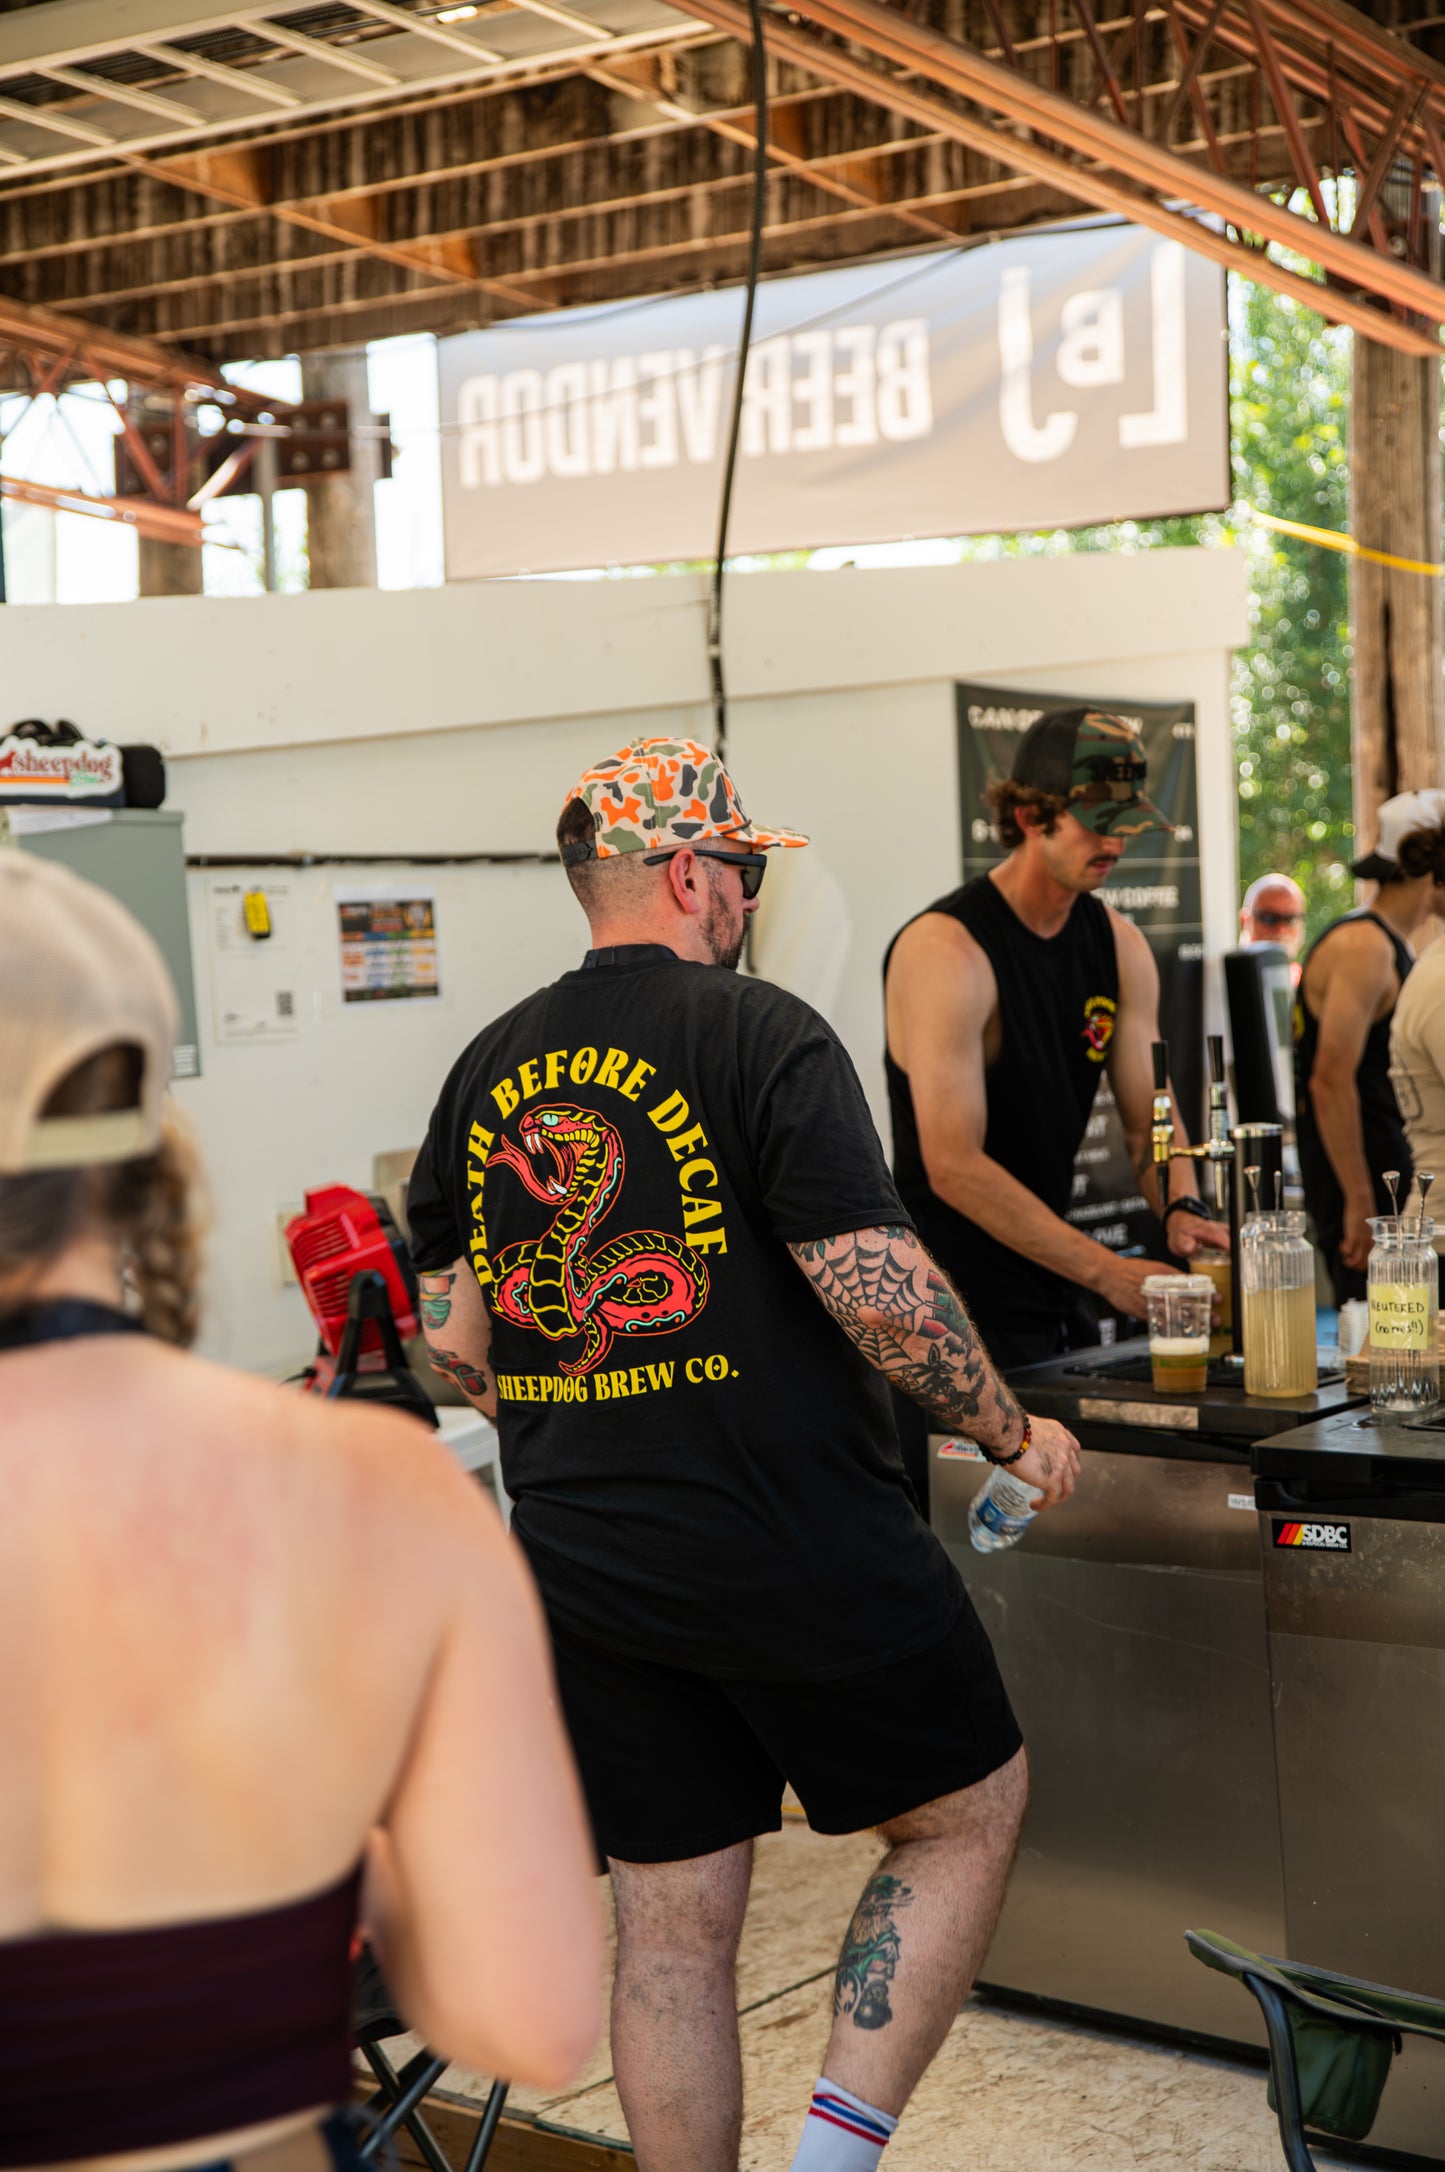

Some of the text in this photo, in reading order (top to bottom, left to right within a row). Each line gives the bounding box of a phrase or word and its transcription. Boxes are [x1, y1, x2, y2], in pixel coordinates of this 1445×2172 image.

[14, 750, 113, 783] sheepdog
[467, 1046, 728, 1287] DEATH BEFORE DECAF
[1370, 1299, 1425, 1314] NEUTERED
[497, 1354, 740, 1402] SHEEPDOG BREW CO.
[1302, 1524, 1347, 1544] SDBC
